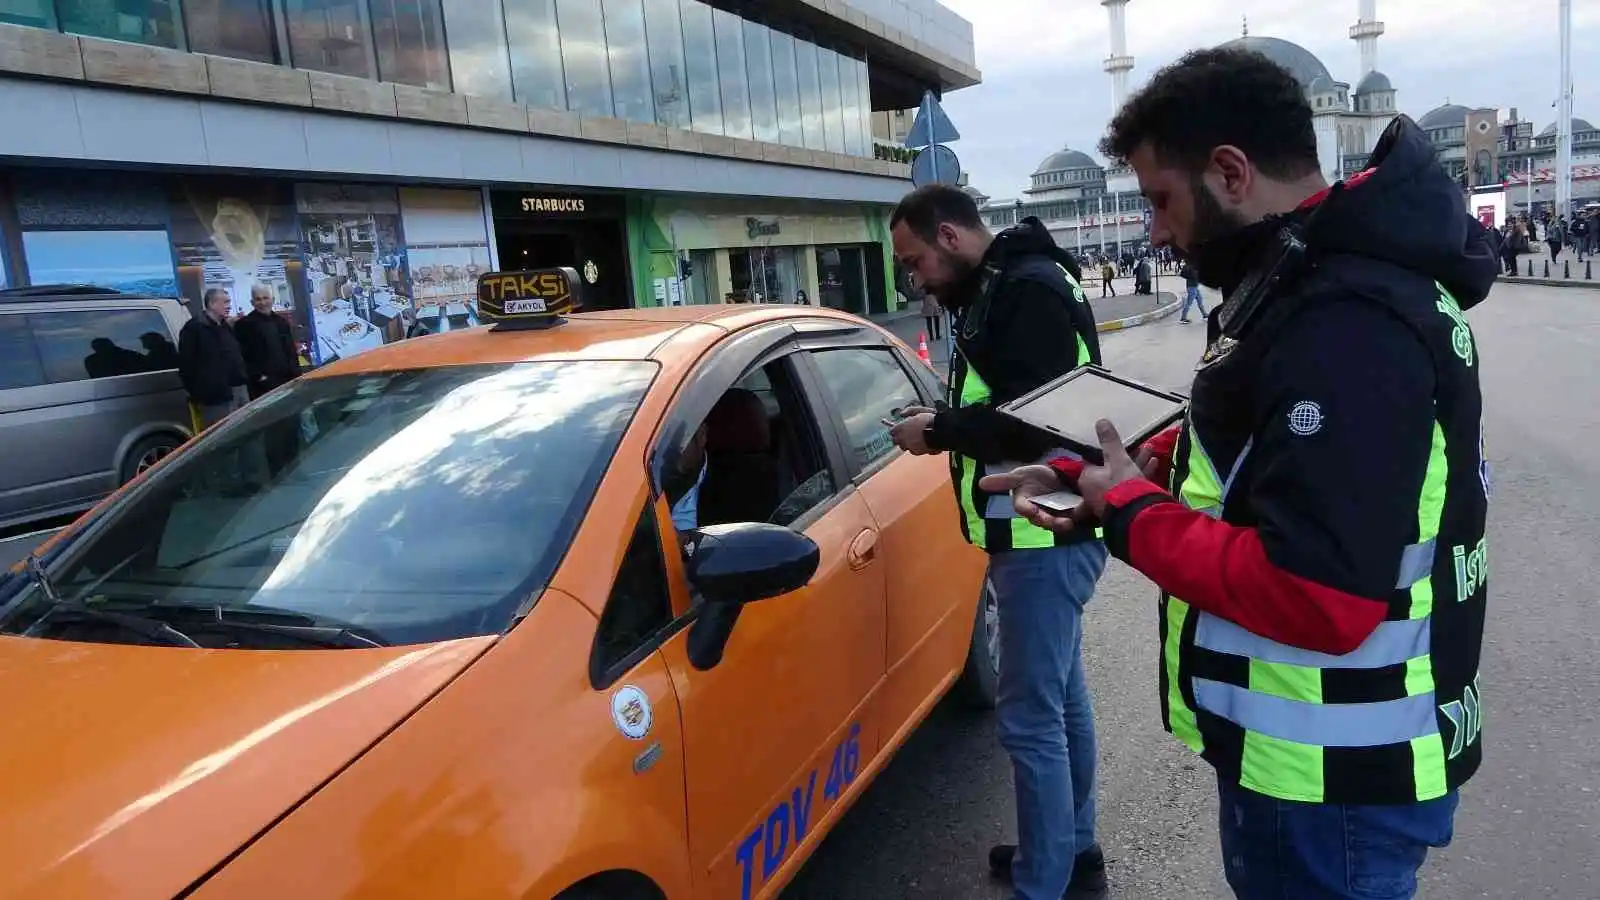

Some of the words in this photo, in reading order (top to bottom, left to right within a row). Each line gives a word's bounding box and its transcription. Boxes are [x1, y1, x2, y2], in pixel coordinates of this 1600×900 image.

[521, 197, 585, 212] STARBUCKS
[735, 770, 818, 900] TDV
[824, 722, 860, 801] 46
